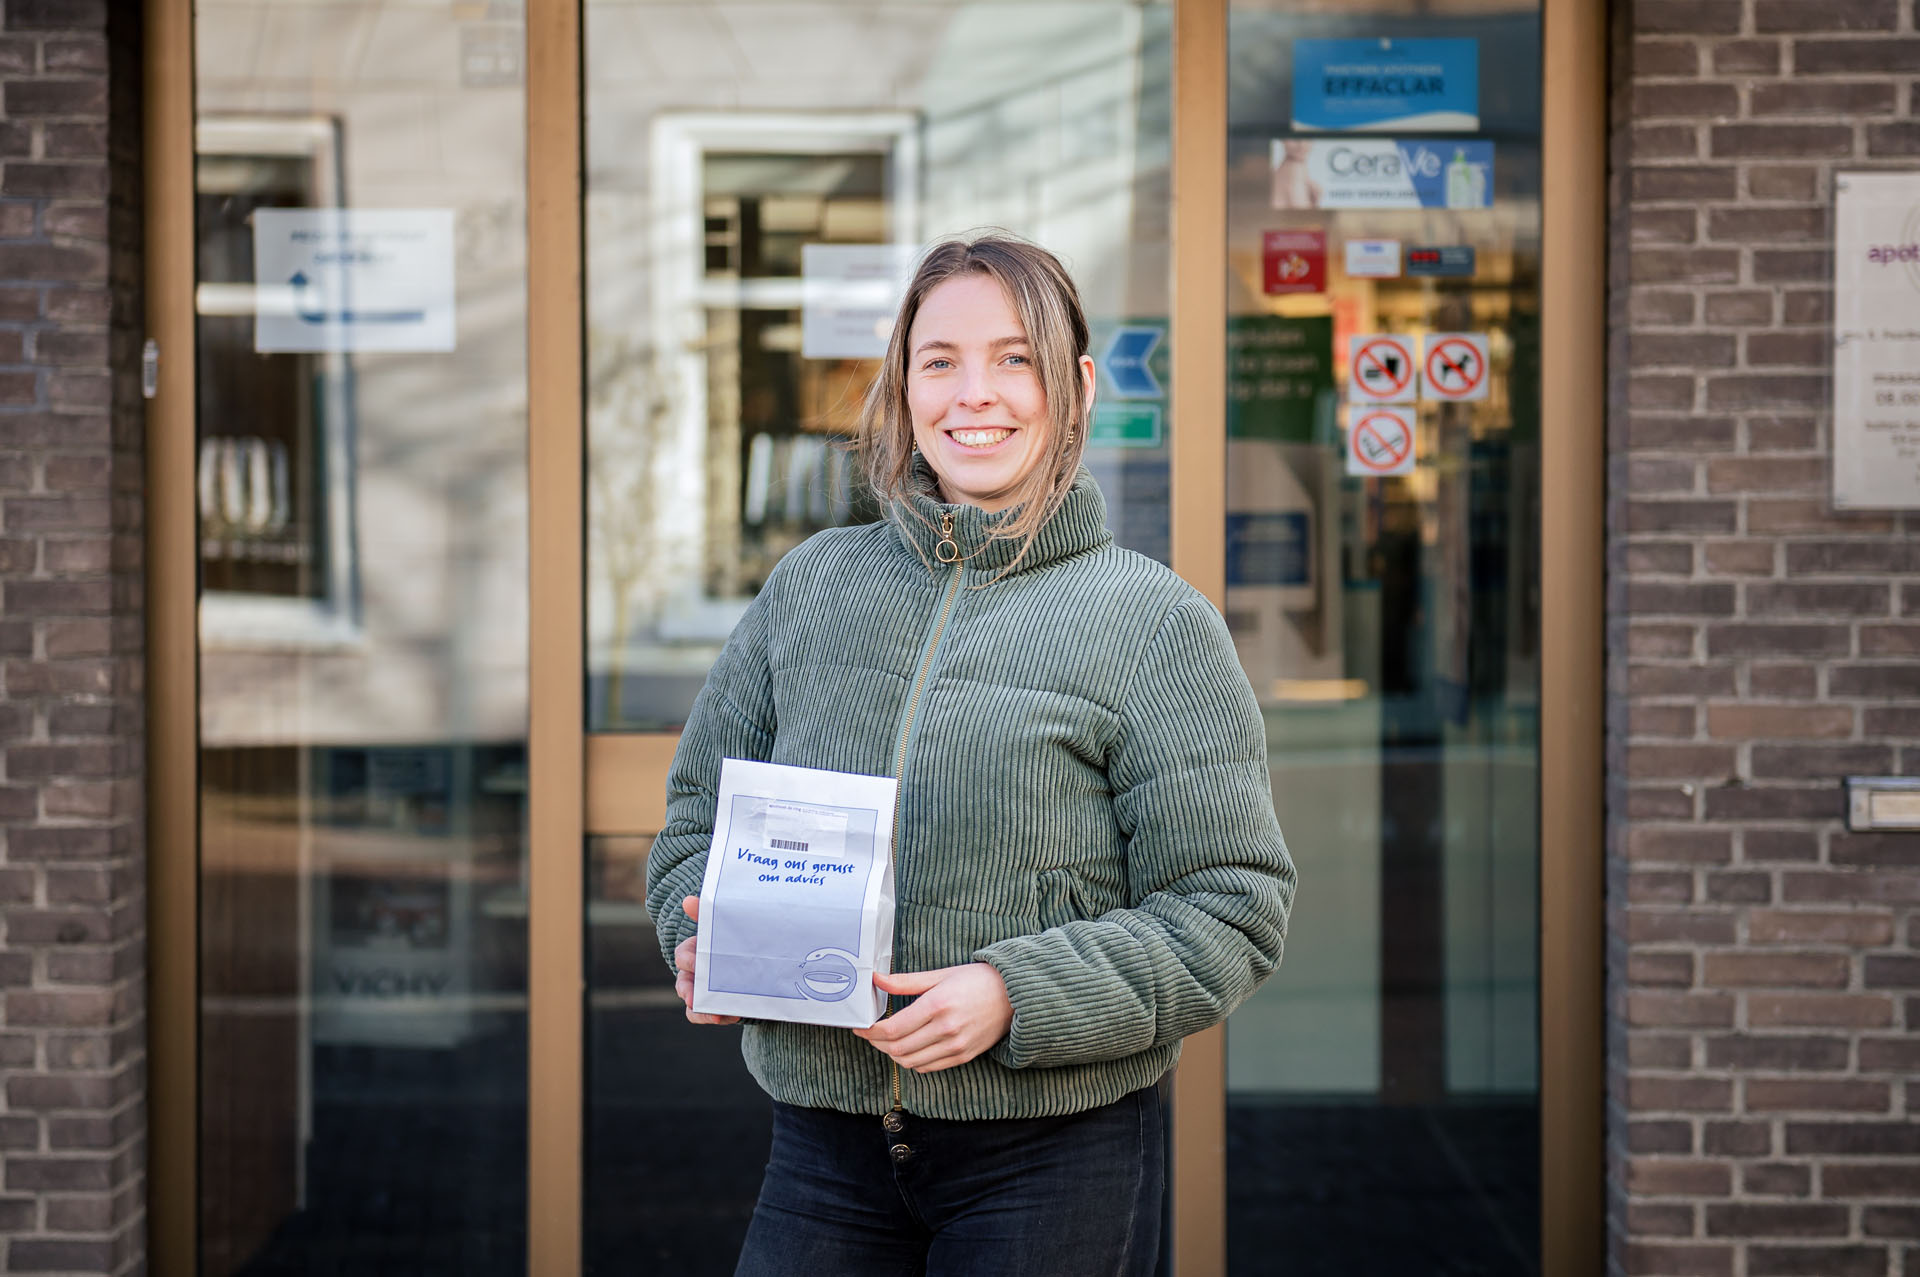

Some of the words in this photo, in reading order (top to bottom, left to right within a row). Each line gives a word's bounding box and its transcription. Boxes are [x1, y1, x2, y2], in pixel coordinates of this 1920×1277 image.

[1325, 77, 1444, 96] EFFACLAR
[1328, 147, 1441, 177] CeraVe
[737, 847, 779, 870] Vraag
[784, 859, 808, 871] ons
[812, 863, 855, 874] gerust
[758, 874, 780, 883] om
[785, 874, 826, 886] advies
[334, 970, 451, 995] VICHY
